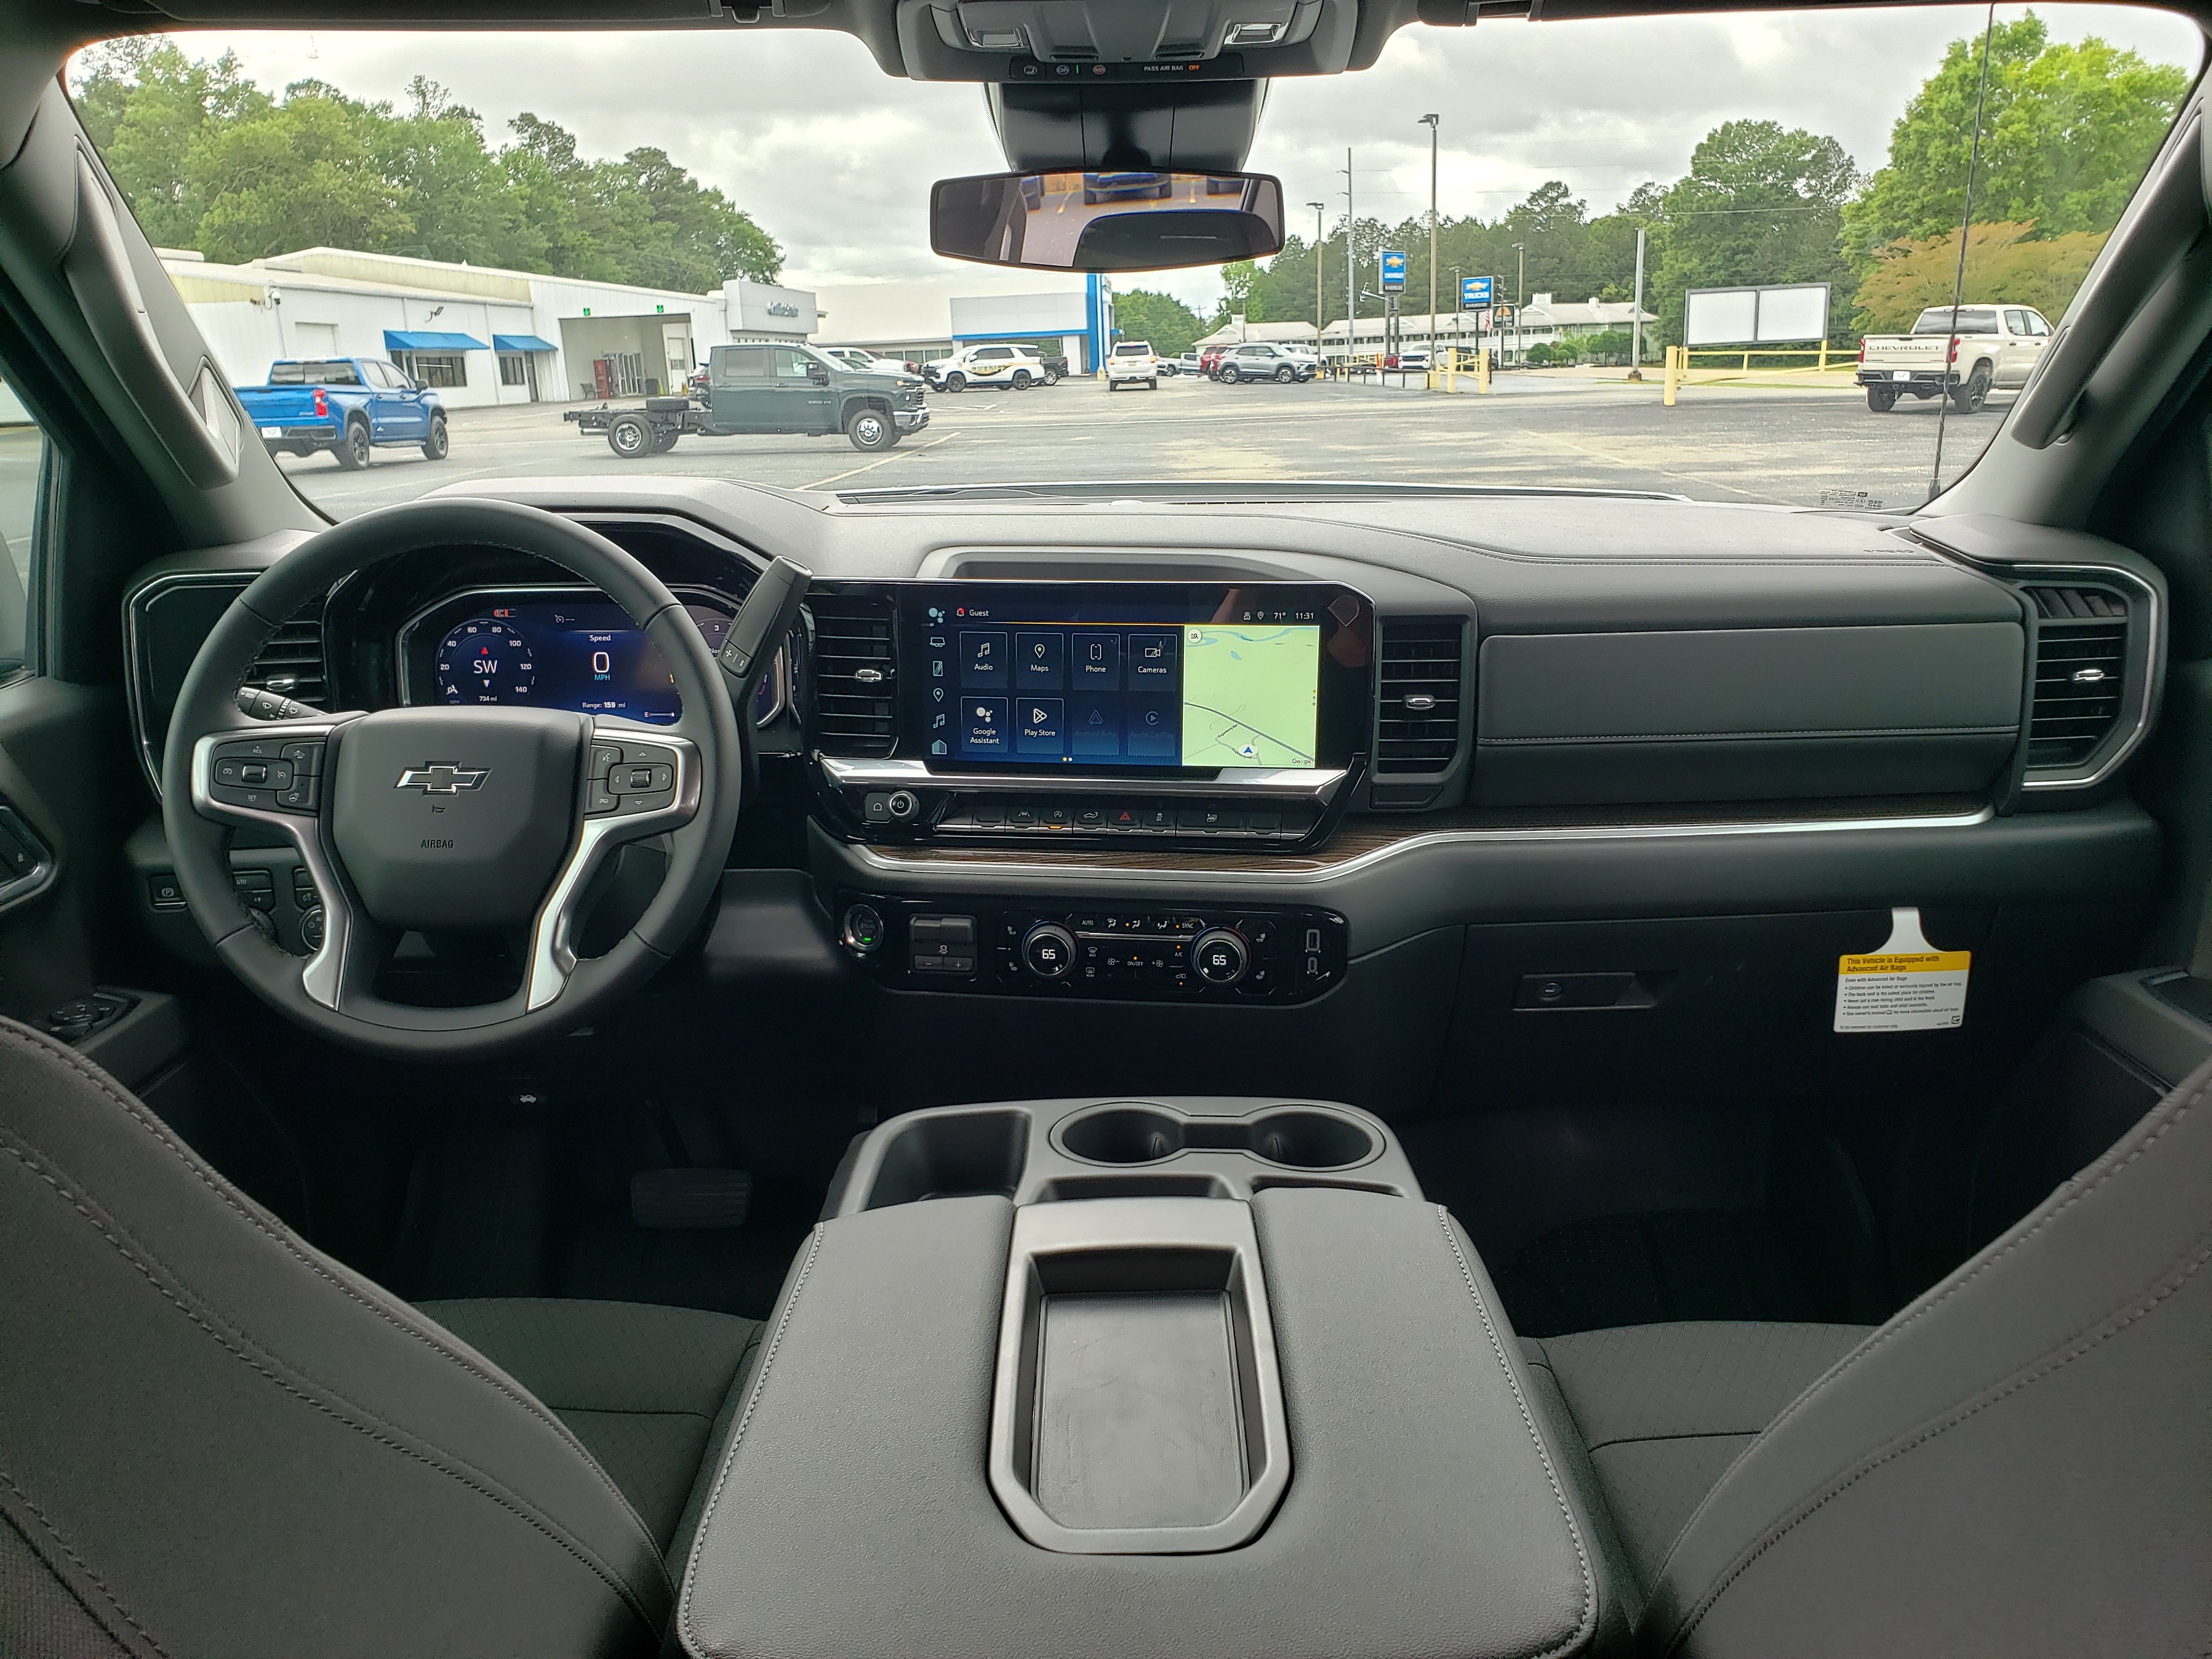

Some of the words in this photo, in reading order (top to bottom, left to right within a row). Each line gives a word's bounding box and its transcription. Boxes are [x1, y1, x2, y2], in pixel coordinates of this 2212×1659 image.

[589, 634, 611, 642] Speed
[473, 660, 498, 674] SW
[593, 652, 610, 673] 0
[1024, 729, 1037, 737] Play
[421, 839, 454, 848] AIRBAG
[1042, 949, 1056, 959] 65
[1212, 955, 1226, 965] 65
